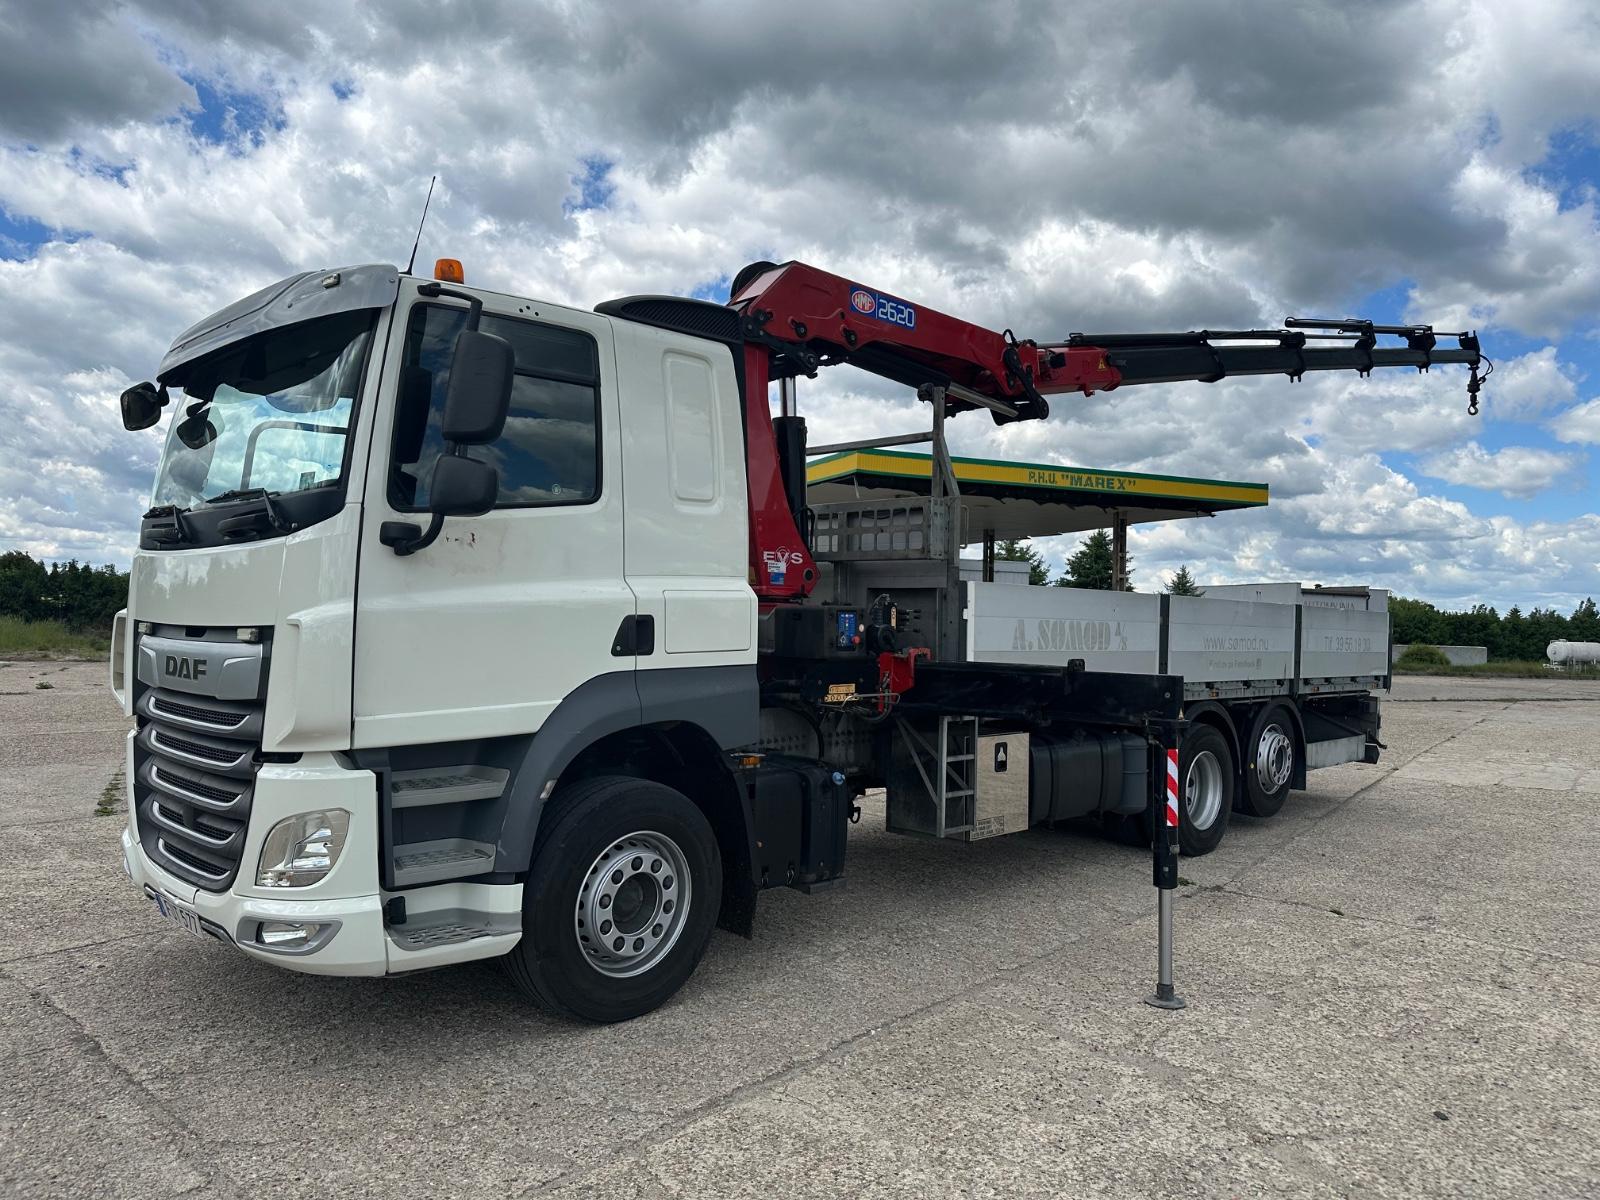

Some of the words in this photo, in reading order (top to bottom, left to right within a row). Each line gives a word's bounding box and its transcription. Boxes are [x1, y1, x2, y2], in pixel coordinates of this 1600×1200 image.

[854, 293, 873, 311] HMF
[878, 299, 915, 327] 2620
[763, 551, 803, 564] EVS
[165, 655, 207, 680] DAF
